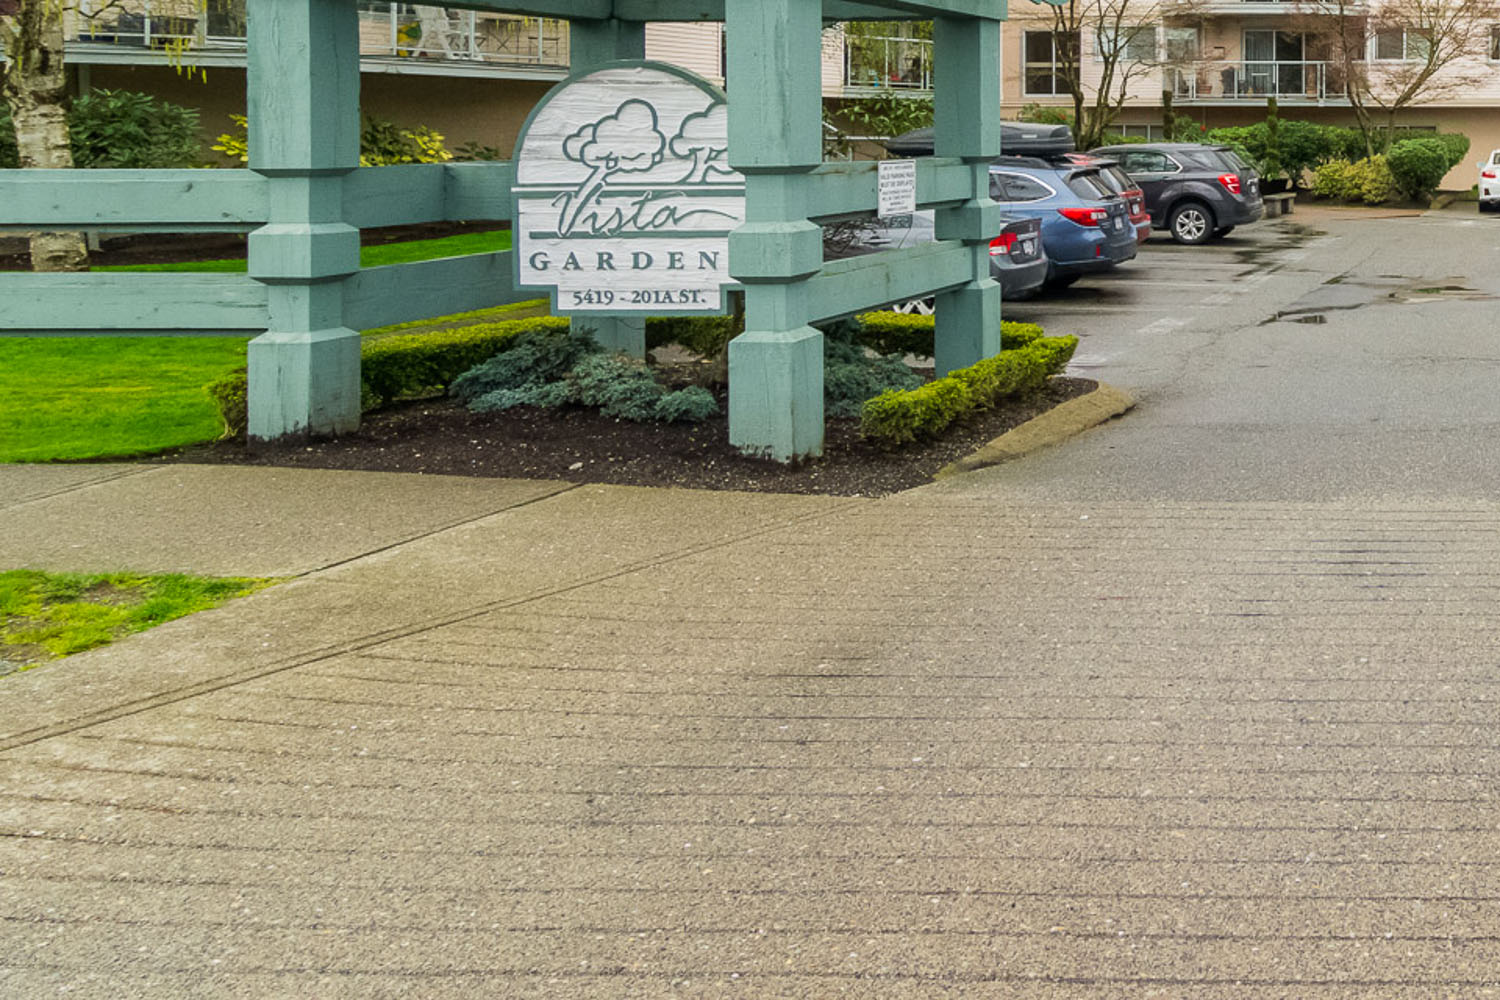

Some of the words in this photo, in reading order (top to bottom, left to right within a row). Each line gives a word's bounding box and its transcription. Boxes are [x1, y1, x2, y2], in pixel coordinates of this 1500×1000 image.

[551, 183, 738, 237] Vista
[573, 289, 614, 306] 5419
[632, 289, 674, 305] 201A
[679, 289, 707, 305] ST.
